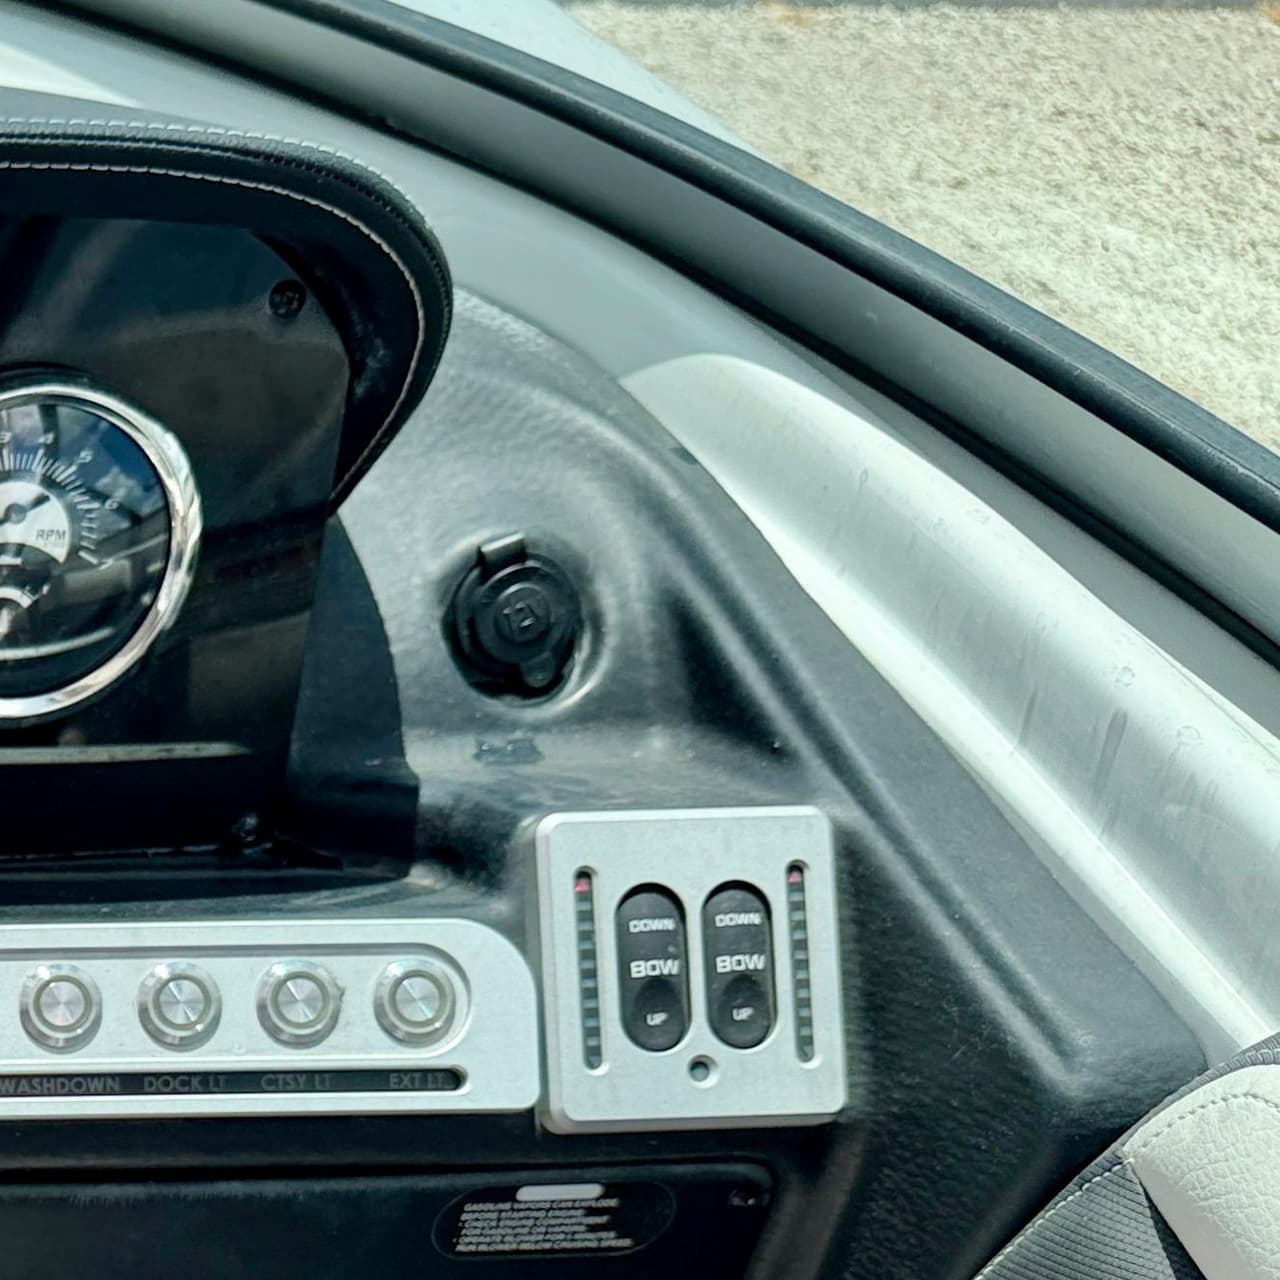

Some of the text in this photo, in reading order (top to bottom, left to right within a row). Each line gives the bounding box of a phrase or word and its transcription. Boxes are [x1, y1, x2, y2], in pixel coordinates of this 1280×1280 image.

[77, 449, 94, 463] 5
[104, 498, 120, 510] 6
[36, 528, 68, 541] RPM
[630, 958, 680, 978] BOW
[716, 954, 766, 973] BOW
[646, 1012, 668, 1026] UP
[732, 1006, 754, 1021] UP
[143, 1074, 227, 1091] DOCK LT
[260, 1073, 334, 1090] CTSY LT
[389, 1072, 446, 1088] EXT LT
